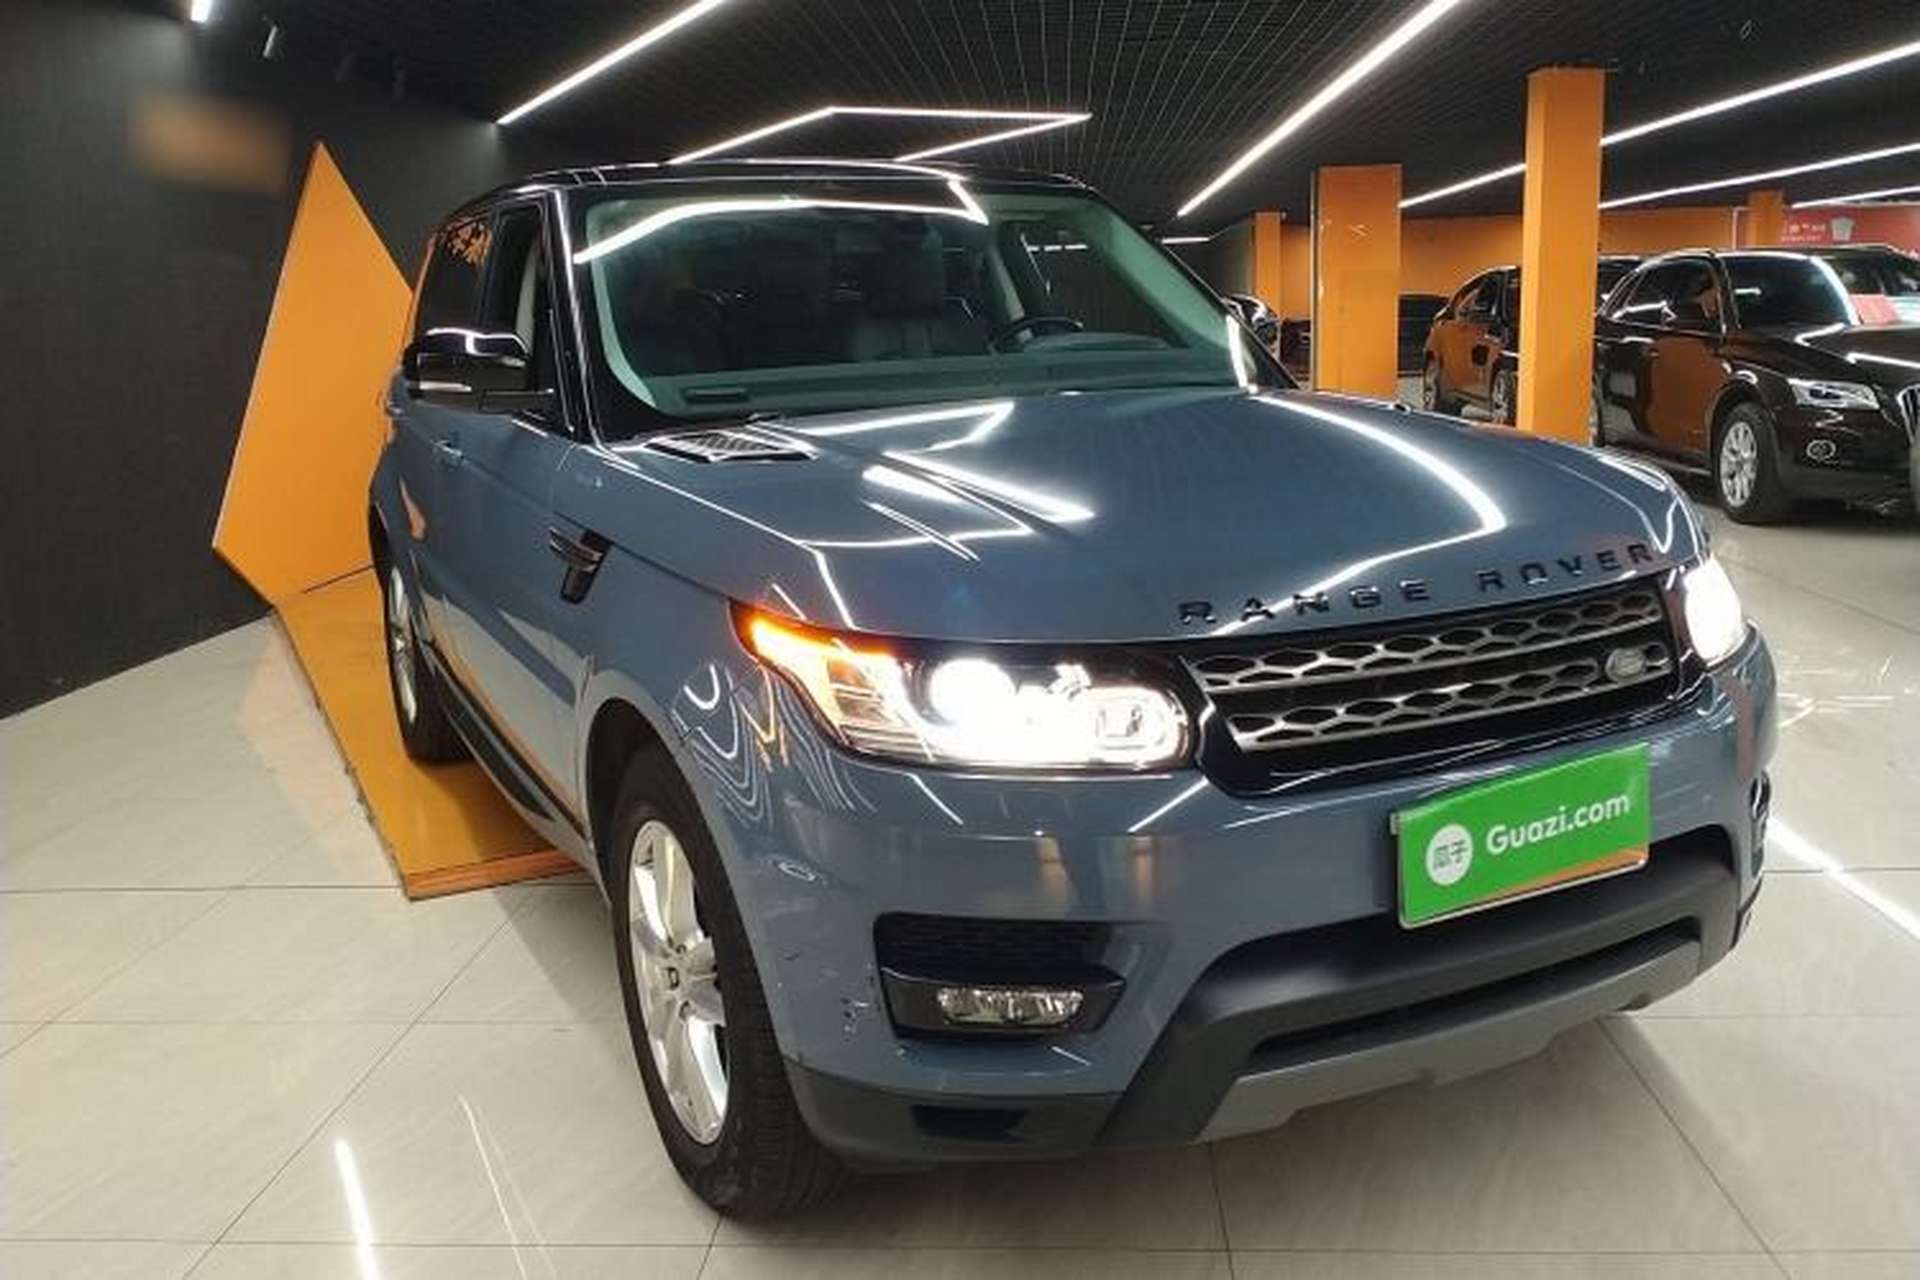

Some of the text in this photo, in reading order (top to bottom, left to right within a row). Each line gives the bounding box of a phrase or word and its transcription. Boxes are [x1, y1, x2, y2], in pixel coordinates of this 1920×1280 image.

[1179, 543, 1652, 624] RANGE ROVER
[1486, 794, 1630, 854] Guazi.com
